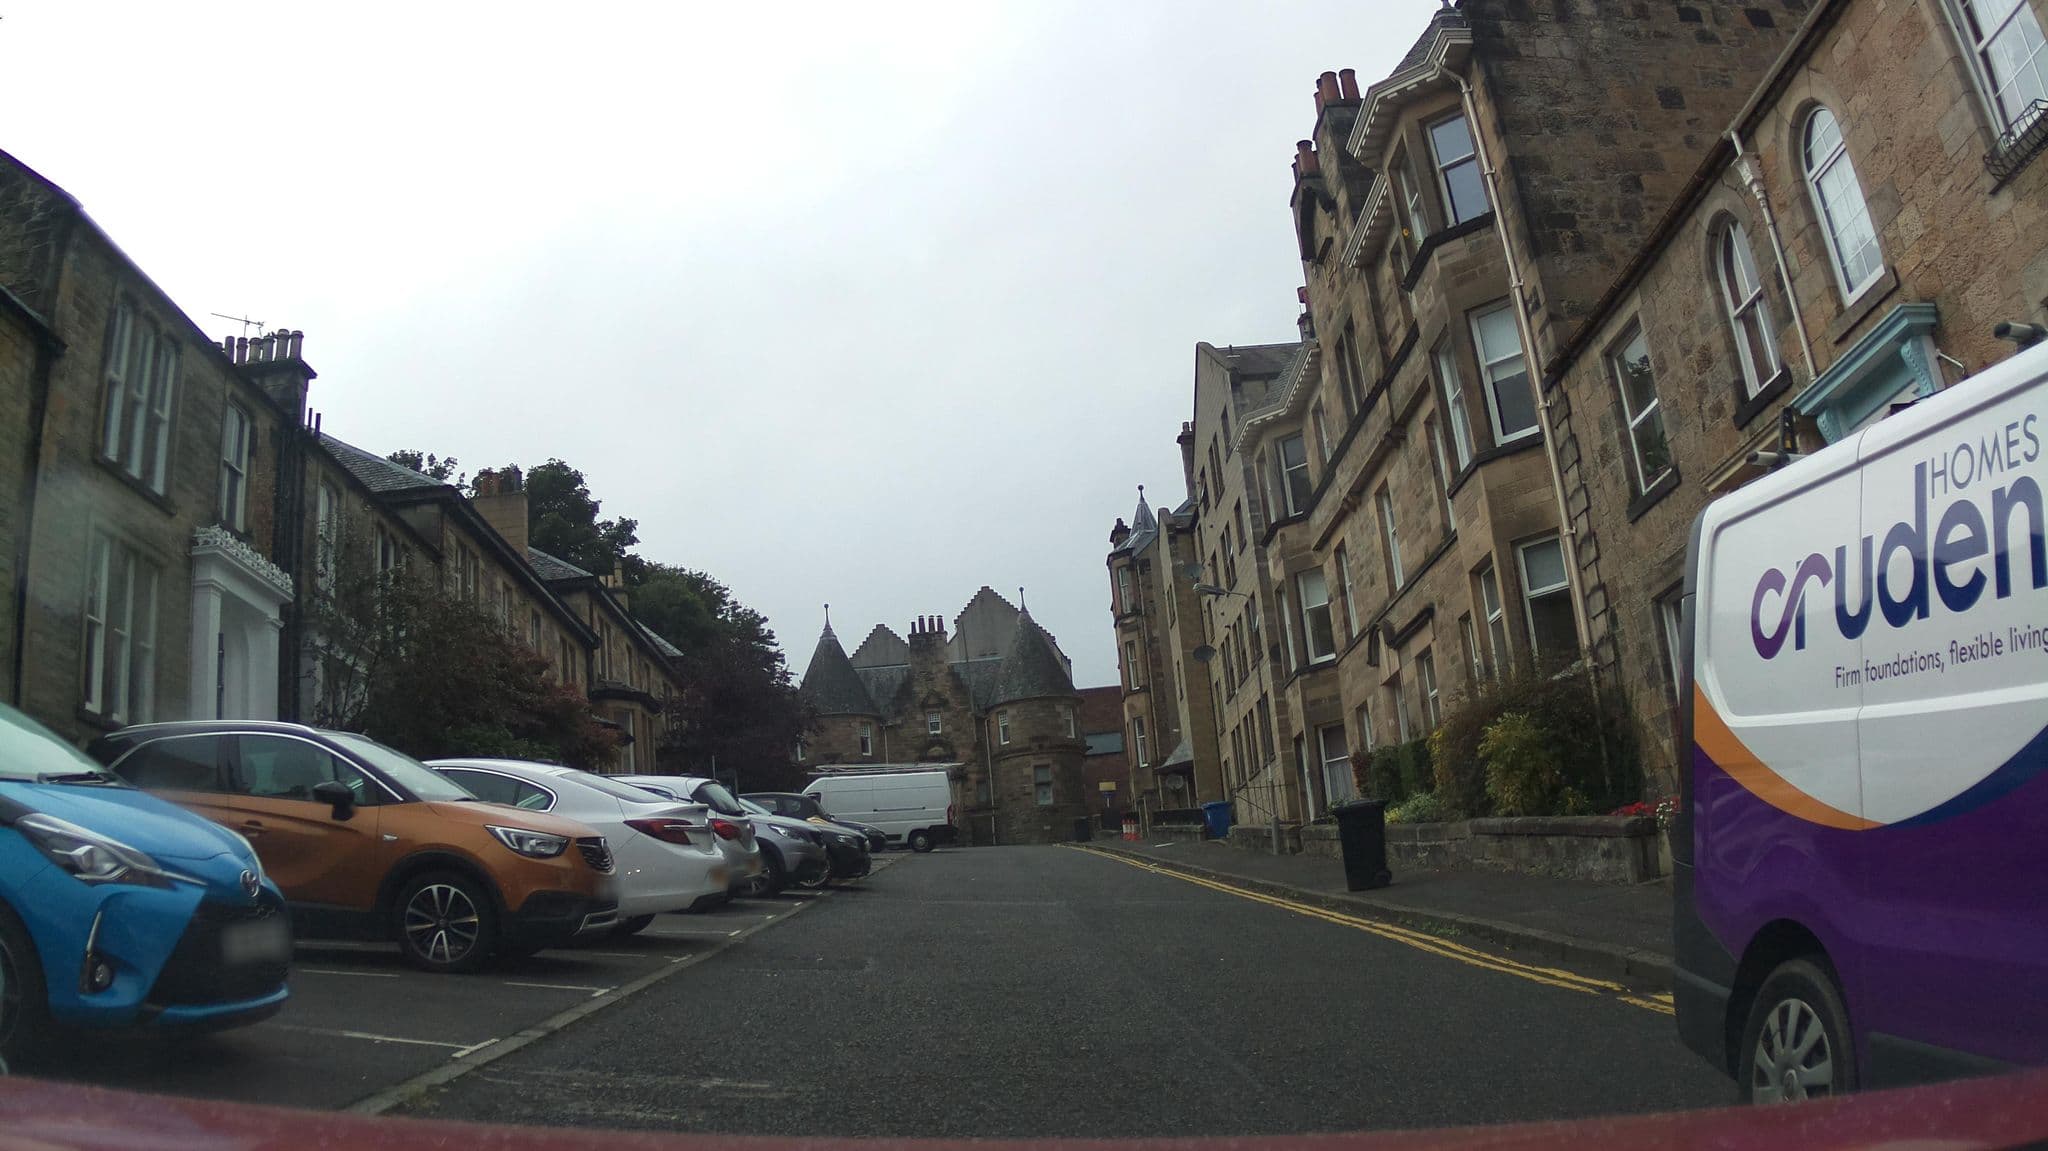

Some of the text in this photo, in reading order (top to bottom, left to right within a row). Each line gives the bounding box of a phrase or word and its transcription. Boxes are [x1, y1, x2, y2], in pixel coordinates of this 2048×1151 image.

[1931, 413, 2040, 499] HOMES
[1751, 461, 2048, 660] cruden
[1835, 666, 1861, 688] Firm
[1865, 650, 1945, 682] foundations,
[1949, 631, 2003, 665] flexible
